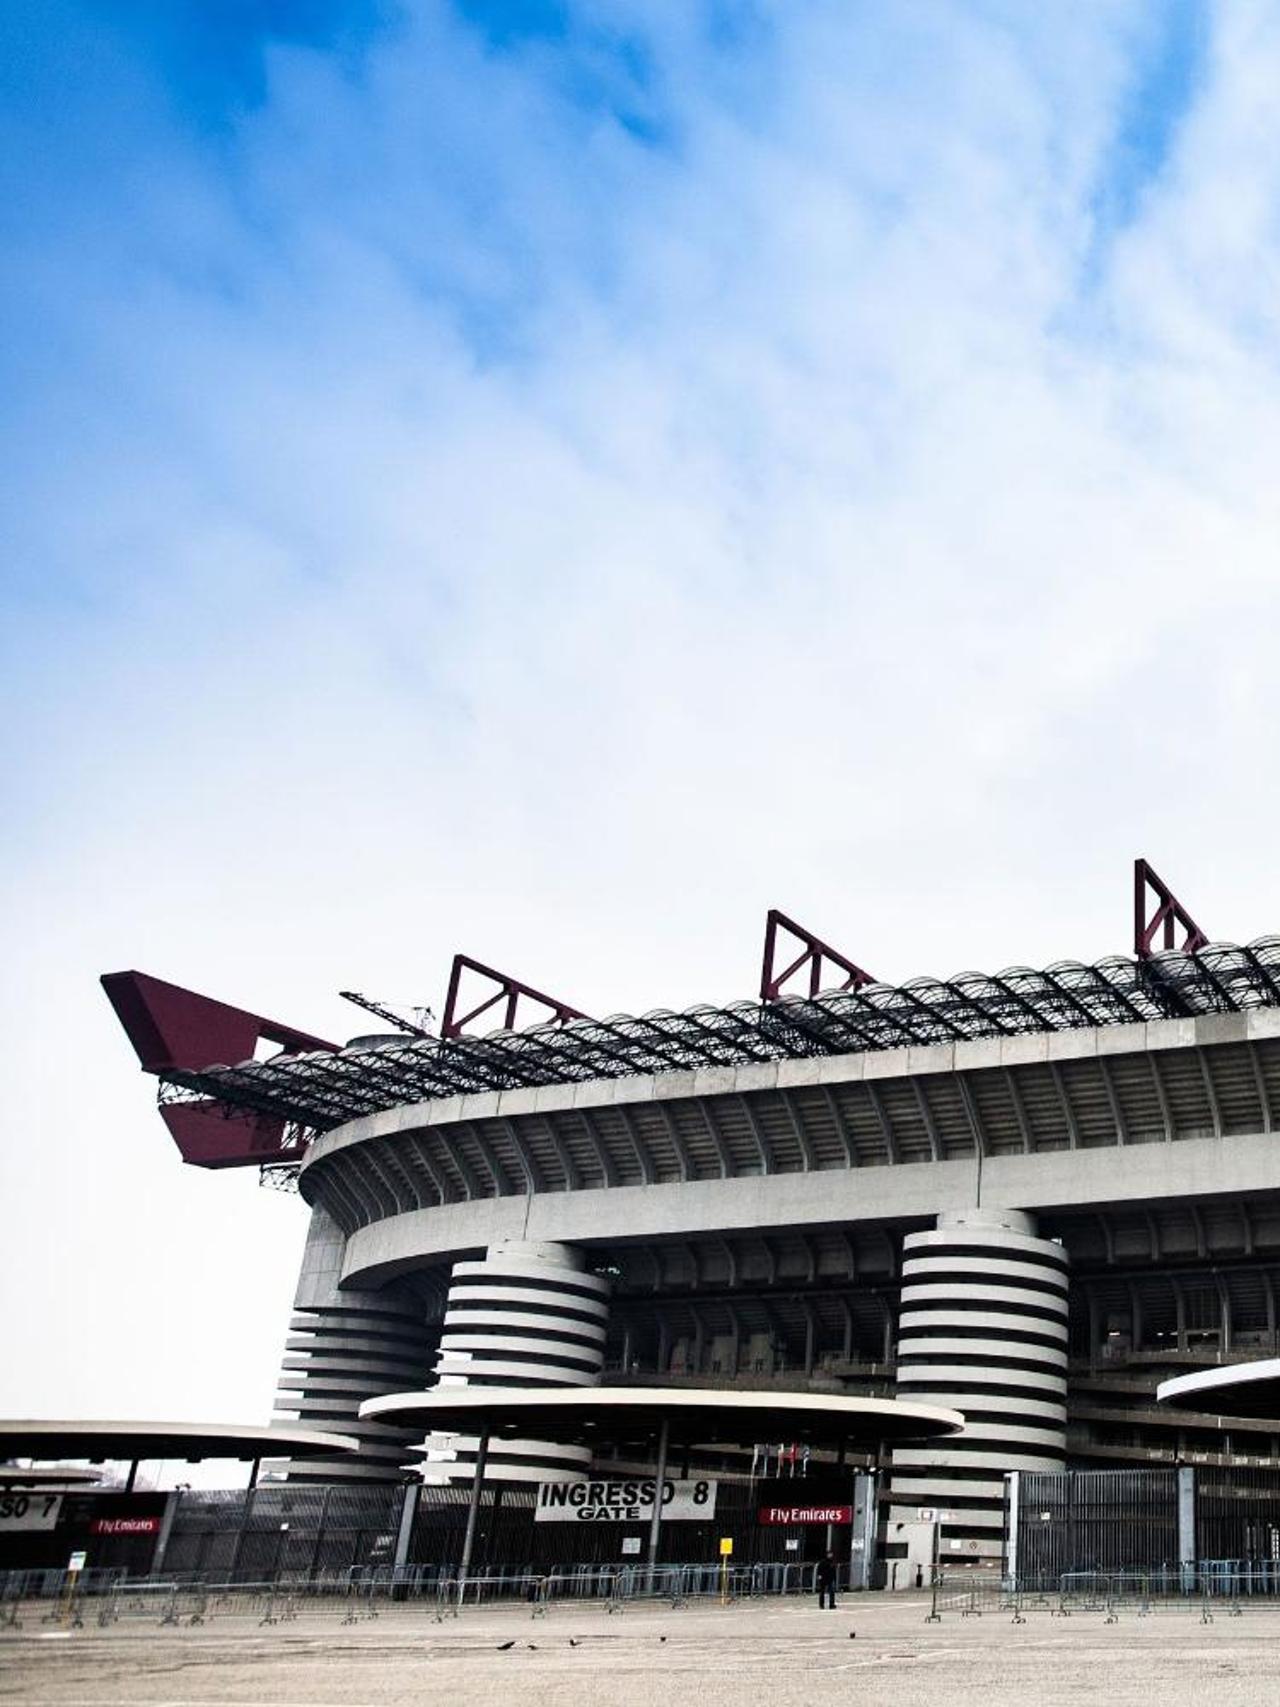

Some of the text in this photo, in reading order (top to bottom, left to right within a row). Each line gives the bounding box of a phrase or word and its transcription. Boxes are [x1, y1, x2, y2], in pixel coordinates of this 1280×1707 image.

[542, 1481, 709, 1507] INGRESSO 8
[42, 1497, 57, 1518] 7
[577, 1506, 640, 1520] GATE
[770, 1507, 842, 1523] Fly Emirates
[98, 1518, 153, 1533] Fly Emirates
